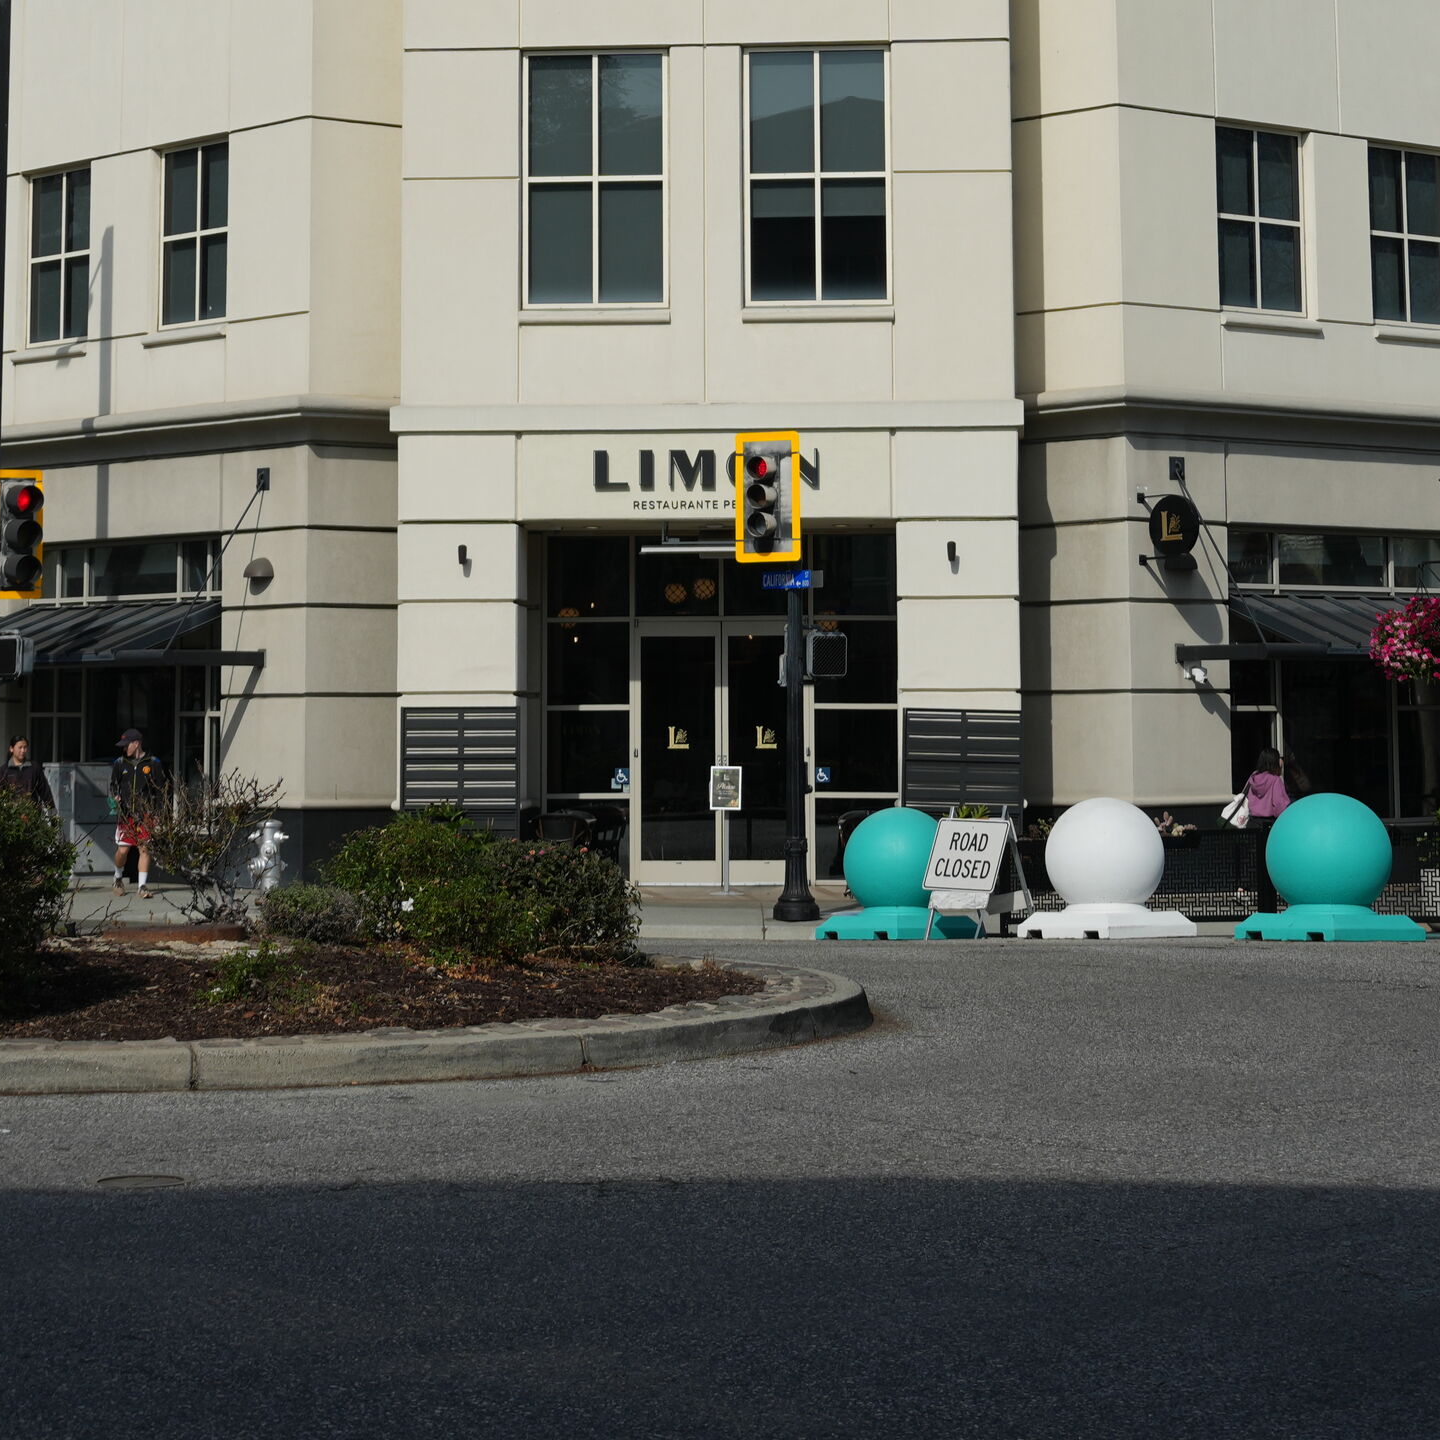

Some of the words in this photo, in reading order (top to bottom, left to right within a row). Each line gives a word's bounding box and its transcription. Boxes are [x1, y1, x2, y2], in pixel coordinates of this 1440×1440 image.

[593, 448, 820, 492] LIMN
[633, 500, 719, 510] RESTAURANTE
[762, 572, 795, 588] CALIFORNIA
[949, 832, 989, 852] ROAD
[934, 858, 992, 879] CLOSED
